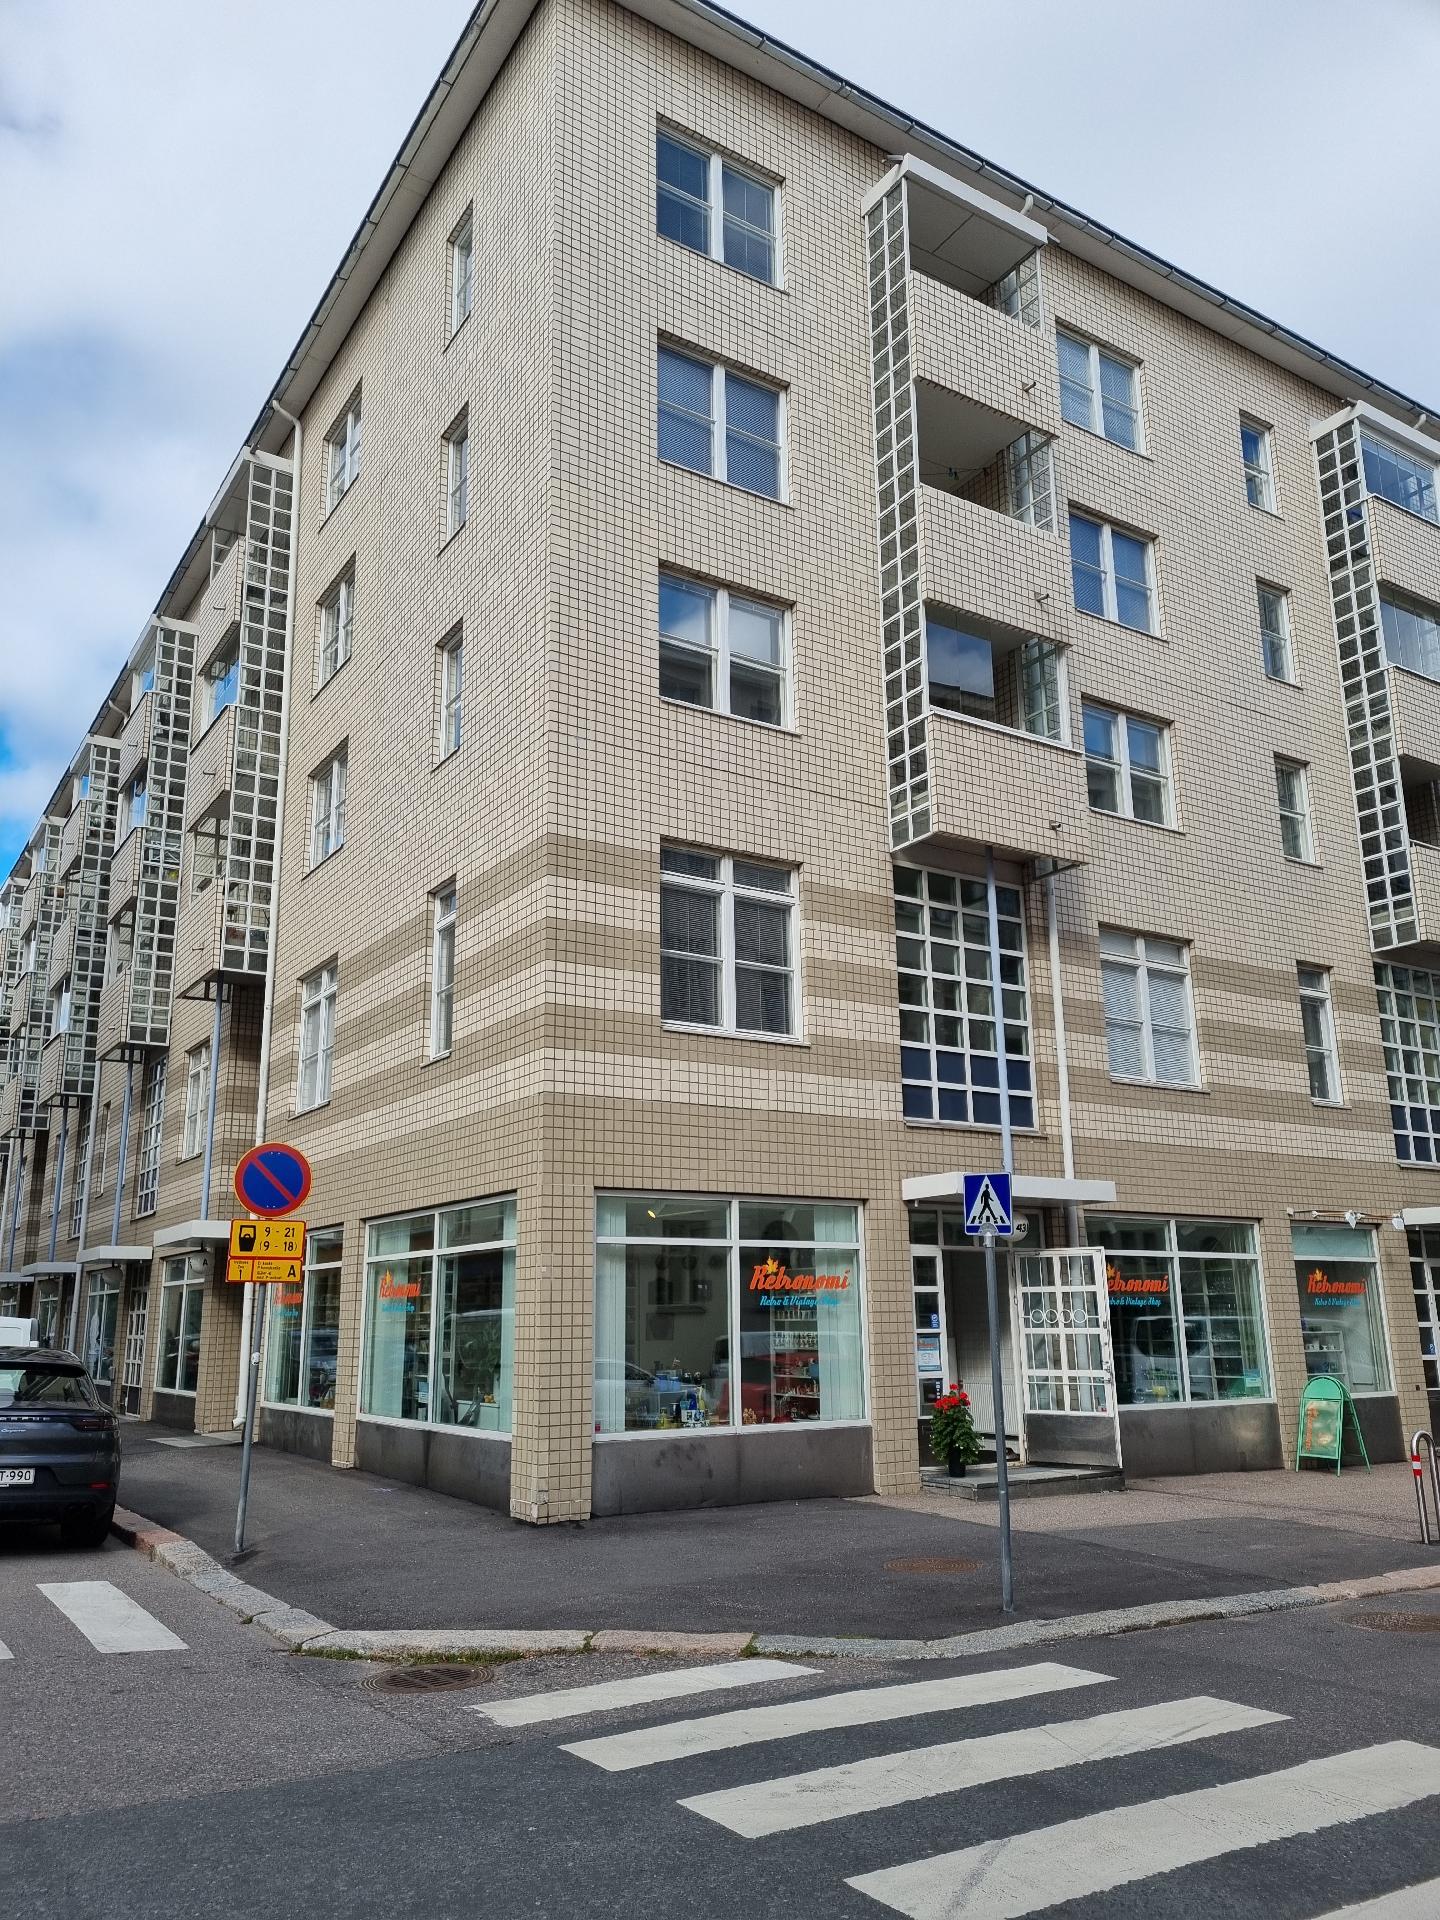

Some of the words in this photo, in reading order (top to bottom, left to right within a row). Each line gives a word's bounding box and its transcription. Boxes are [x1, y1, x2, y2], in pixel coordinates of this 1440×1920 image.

[264, 1226, 271, 1237] 9
[284, 1227, 295, 1238] 21
[259, 1240, 270, 1251] (9
[283, 1241, 298, 1252] 18)
[287, 1264, 297, 1278] A
[749, 1264, 850, 1290] Retronomi
[1107, 1271, 1169, 1292] etronomi
[760, 1295, 782, 1306] Retro
[783, 1295, 791, 1306] &
